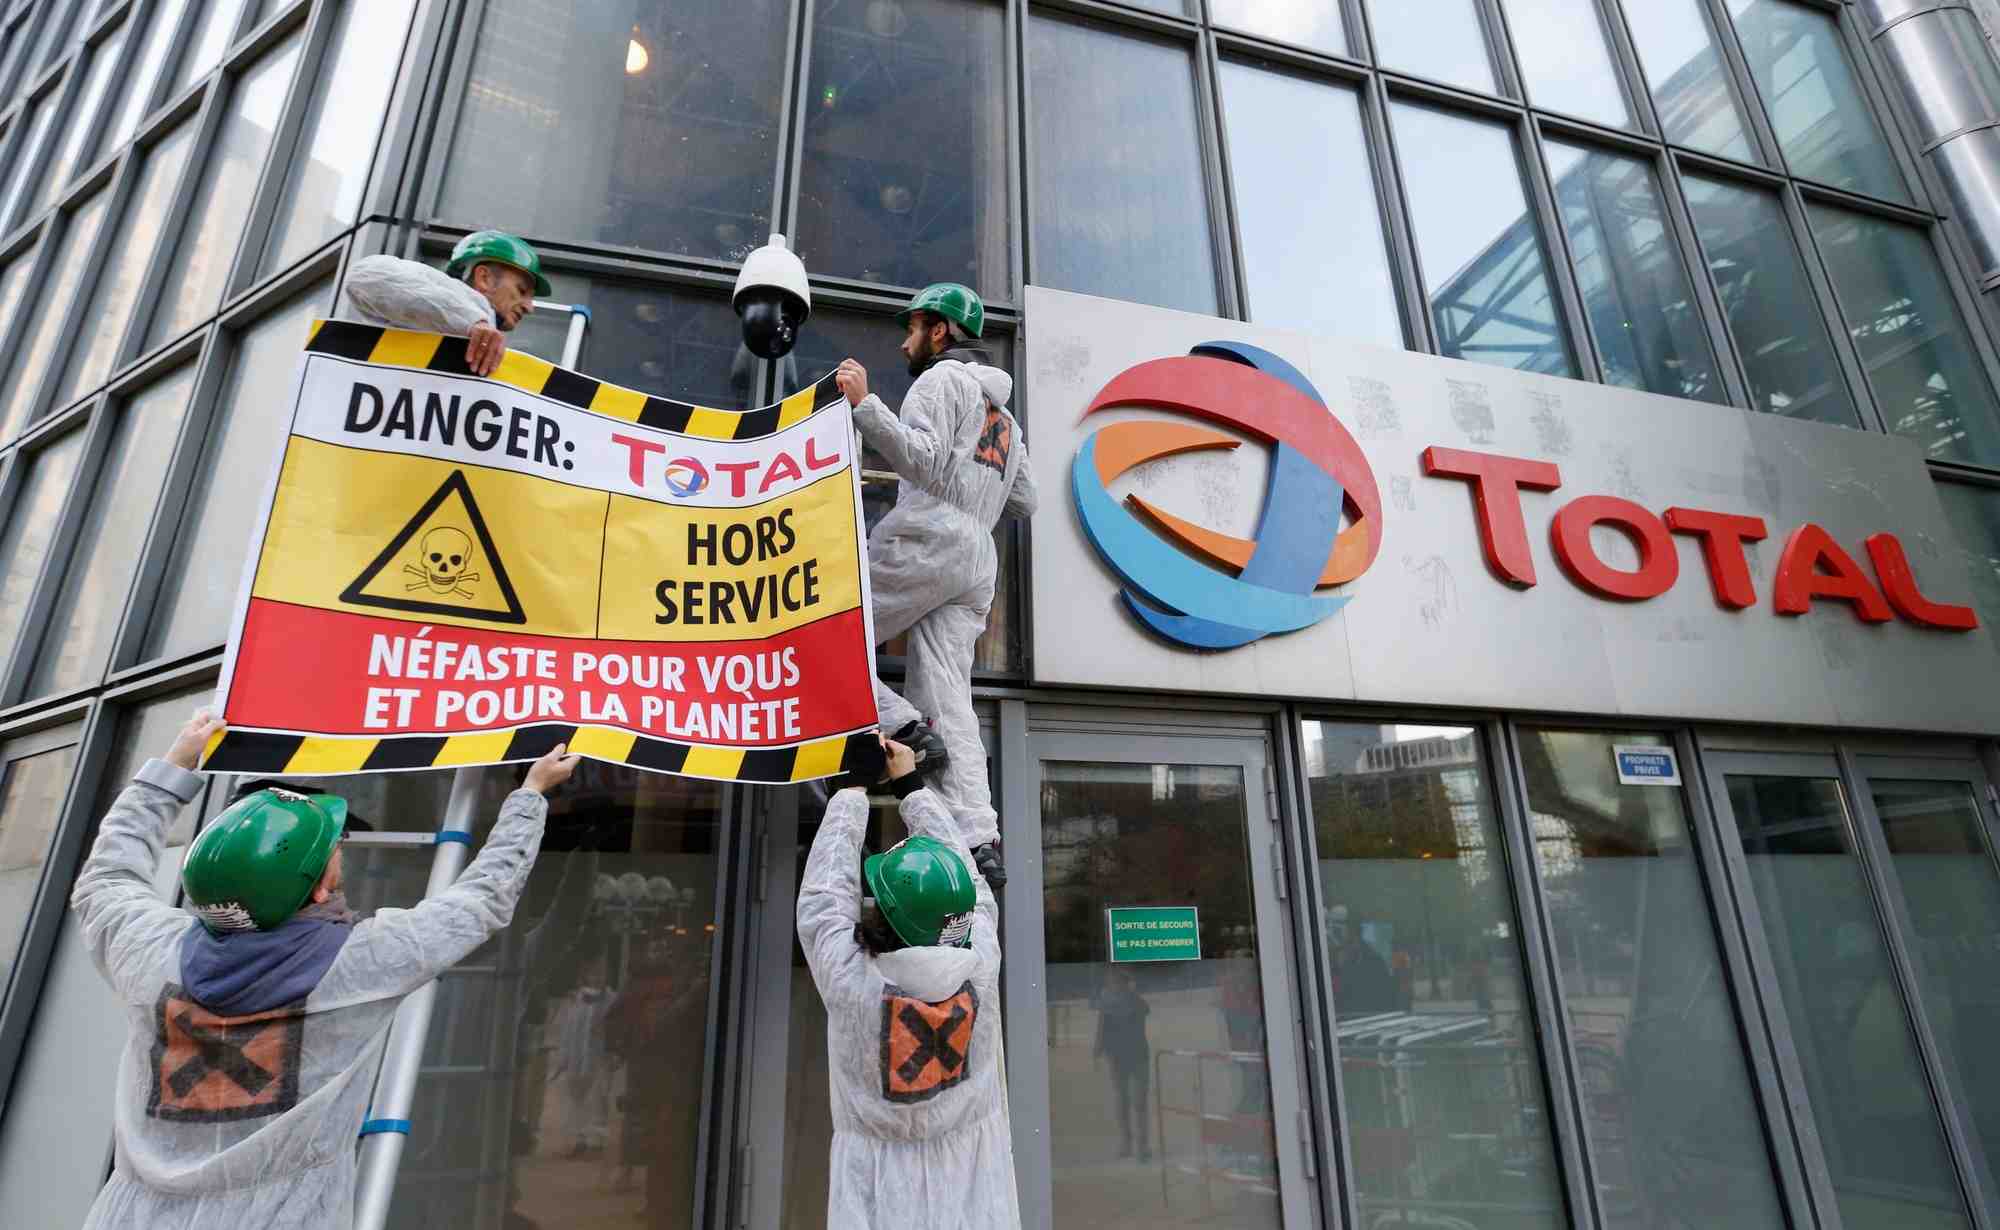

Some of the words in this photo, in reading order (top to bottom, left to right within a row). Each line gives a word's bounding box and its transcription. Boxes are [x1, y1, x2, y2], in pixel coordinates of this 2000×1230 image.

[344, 382, 575, 471] DANGER:
[611, 433, 841, 498] TOTAL
[687, 508, 796, 566] HORS
[1422, 446, 1978, 631] TOTAL
[655, 558, 820, 625] SERVICE
[368, 626, 557, 681] NÉFASTE
[572, 651, 686, 693] POUR
[695, 646, 800, 694] VOUS
[363, 687, 421, 728] ET
[434, 684, 565, 726] POUR
[580, 690, 629, 723] LA
[641, 690, 801, 741] PLANÈTE
[1115, 921, 1145, 930] SORTIE
[1146, 921, 1158, 929] DE
[1159, 920, 1193, 929] SECOURS
[1117, 940, 1129, 948] NE
[1129, 939, 1146, 948] PAS
[1147, 938, 1194, 948] ENCOMBRER
